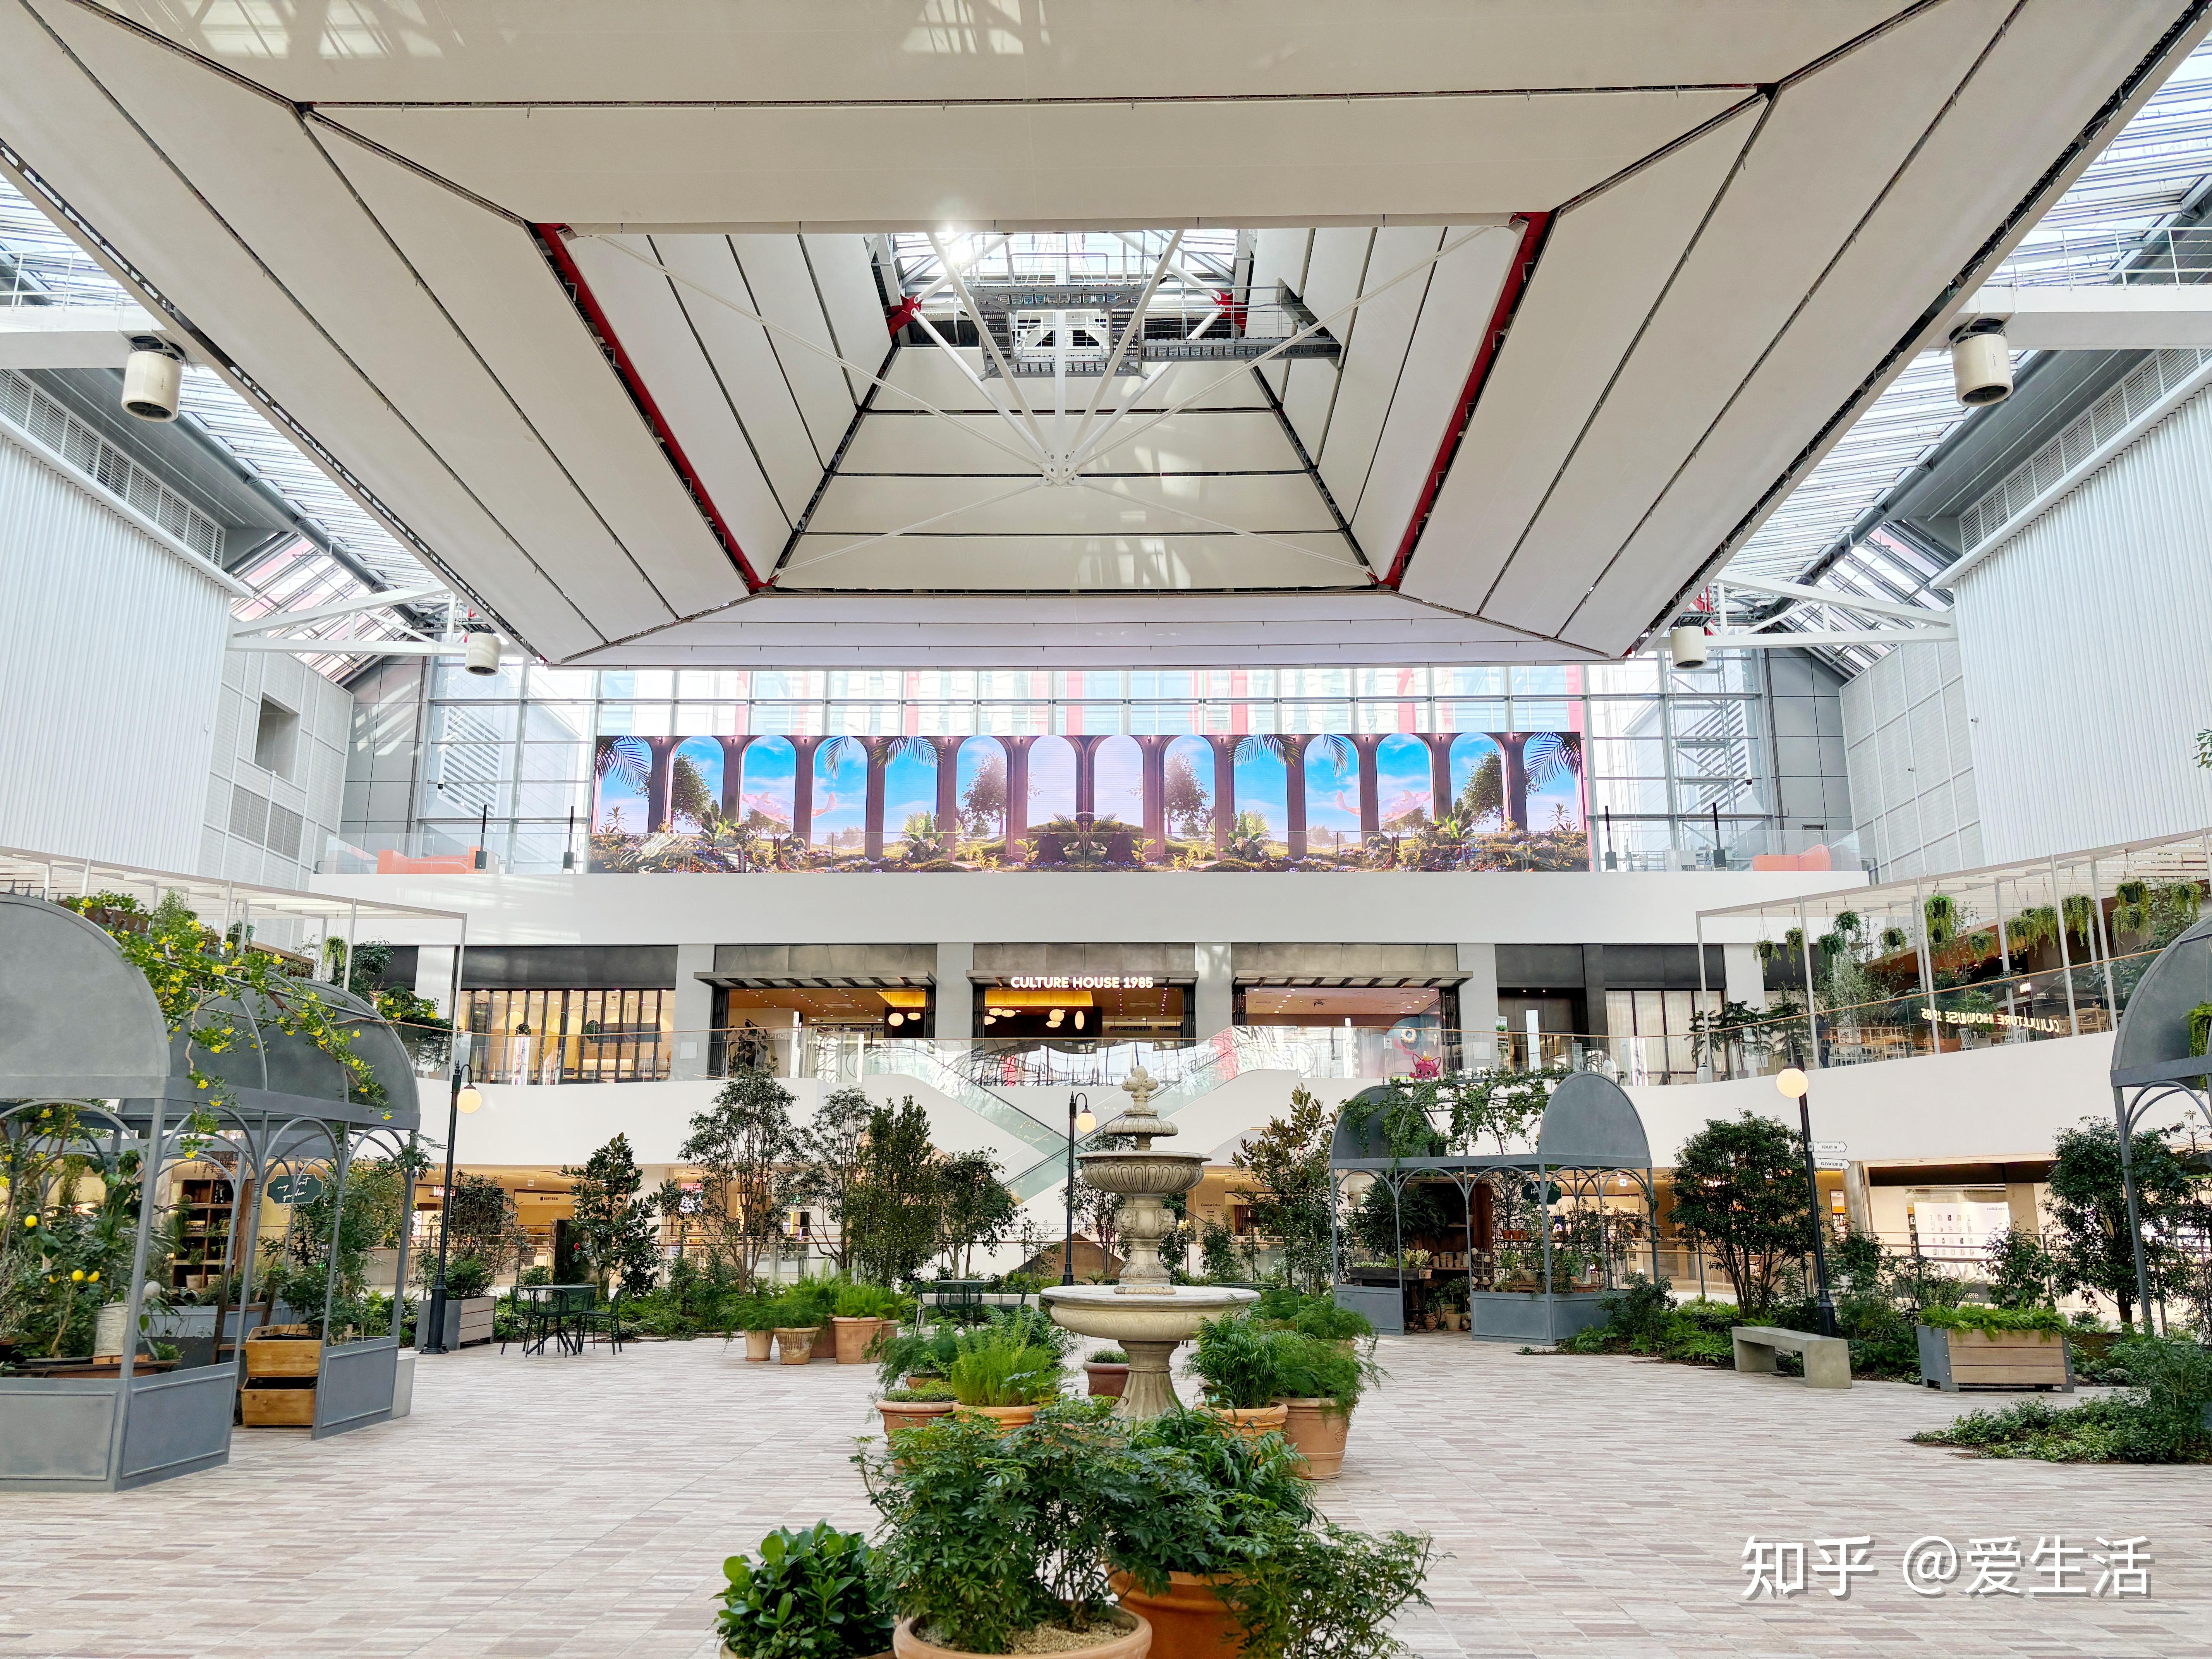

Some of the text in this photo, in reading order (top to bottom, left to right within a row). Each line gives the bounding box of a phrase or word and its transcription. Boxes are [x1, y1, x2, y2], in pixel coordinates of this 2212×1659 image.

[1010, 977, 1154, 988] CULTURE HOUSE 1985
[283, 1188, 306, 1202] gaden
